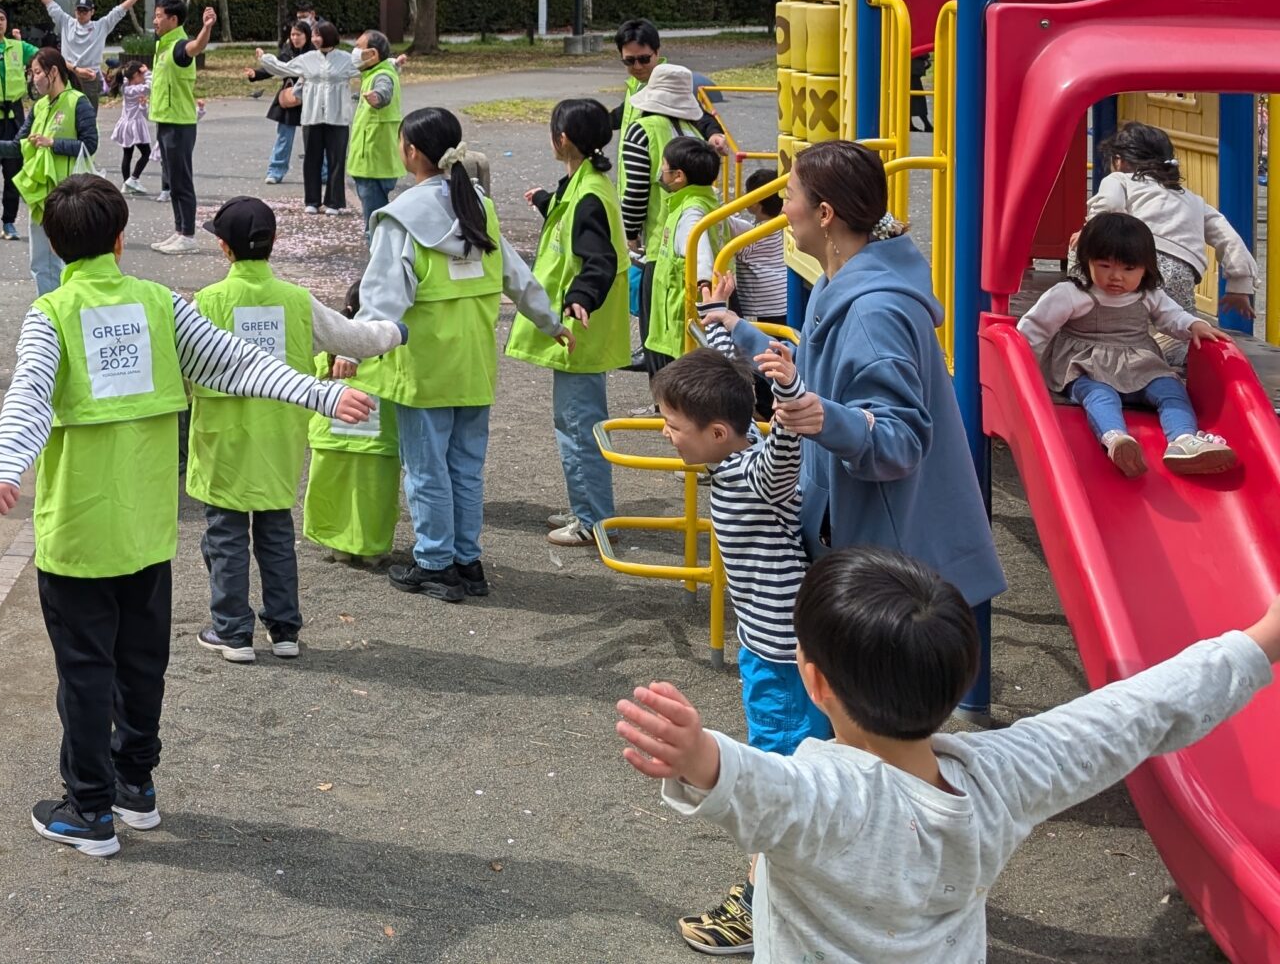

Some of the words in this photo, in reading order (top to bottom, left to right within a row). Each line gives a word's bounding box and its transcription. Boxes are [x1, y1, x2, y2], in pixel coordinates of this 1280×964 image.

[92, 322, 141, 338] GREEN
[241, 321, 278, 331] GREEN
[100, 343, 138, 358] EXPO
[101, 356, 139, 370] 2027
